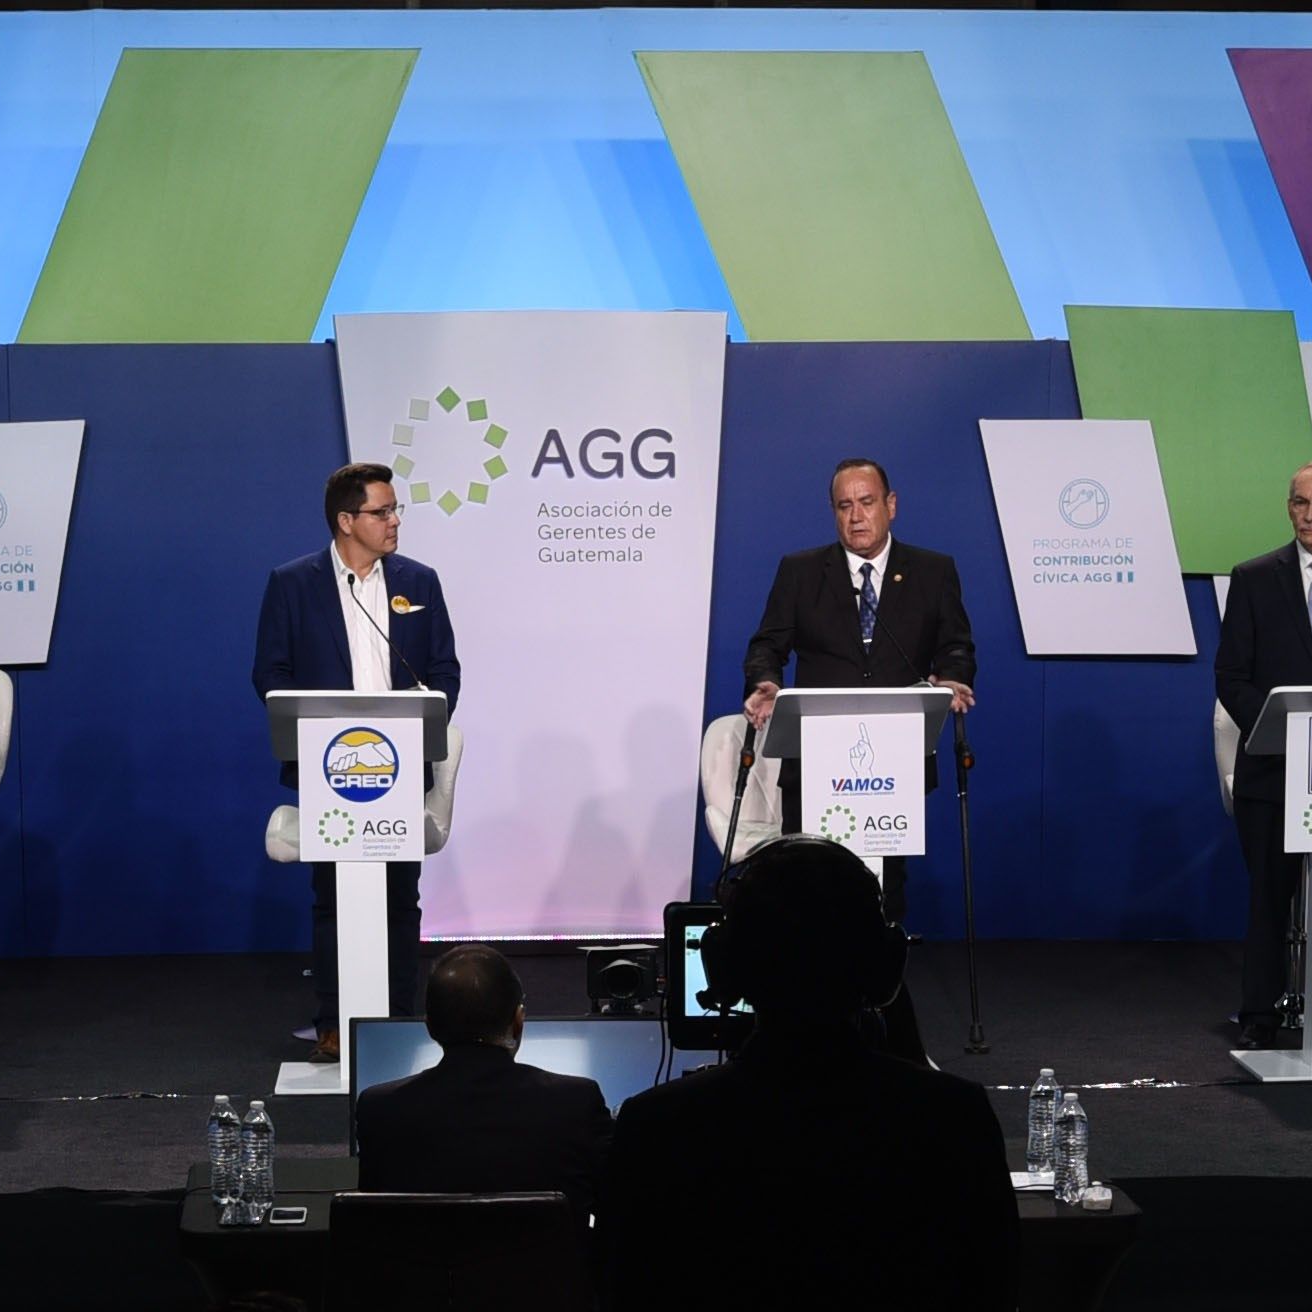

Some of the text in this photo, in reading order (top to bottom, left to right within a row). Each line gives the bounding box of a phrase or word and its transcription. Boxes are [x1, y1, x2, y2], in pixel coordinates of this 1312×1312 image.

[531, 428, 676, 480] AGG
[537, 501, 672, 518] Asociación de
[538, 523, 656, 540] Gerentes de
[1032, 537, 1134, 550] PROGRAMA DE
[15, 545, 33, 557] DE
[538, 546, 643, 563] Guatemala
[1032, 553, 1134, 566] CONTRIBUCIÓN
[1033, 571, 1113, 583] CÍVICA AGG
[329, 774, 393, 788] CREO
[832, 777, 895, 791] VAMOS
[362, 820, 407, 835] AGG
[864, 815, 907, 831] AGG
